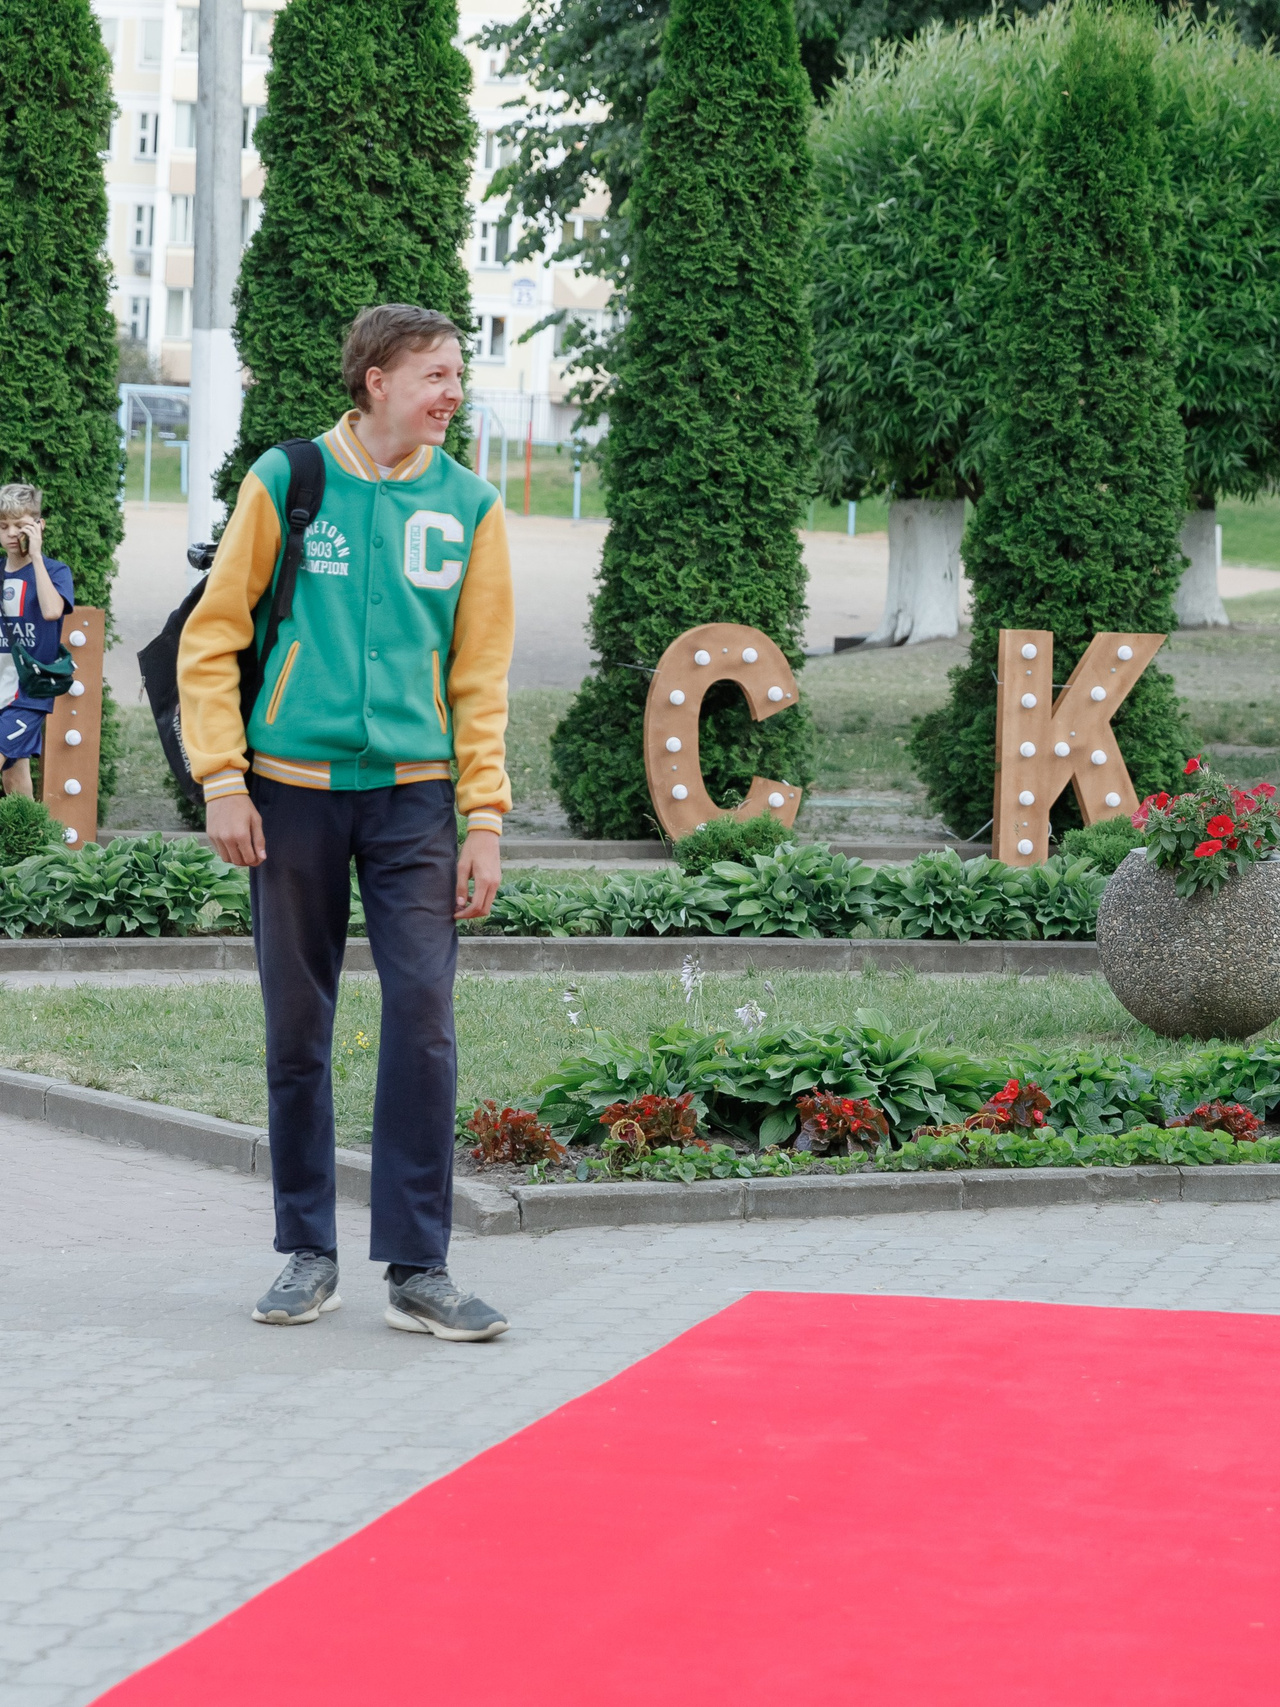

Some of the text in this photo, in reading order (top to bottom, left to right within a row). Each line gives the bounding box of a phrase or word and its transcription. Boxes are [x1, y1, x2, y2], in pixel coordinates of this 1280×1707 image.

[304, 519, 351, 558] METOWN
[305, 540, 333, 559] 1903
[404, 509, 464, 590] C
